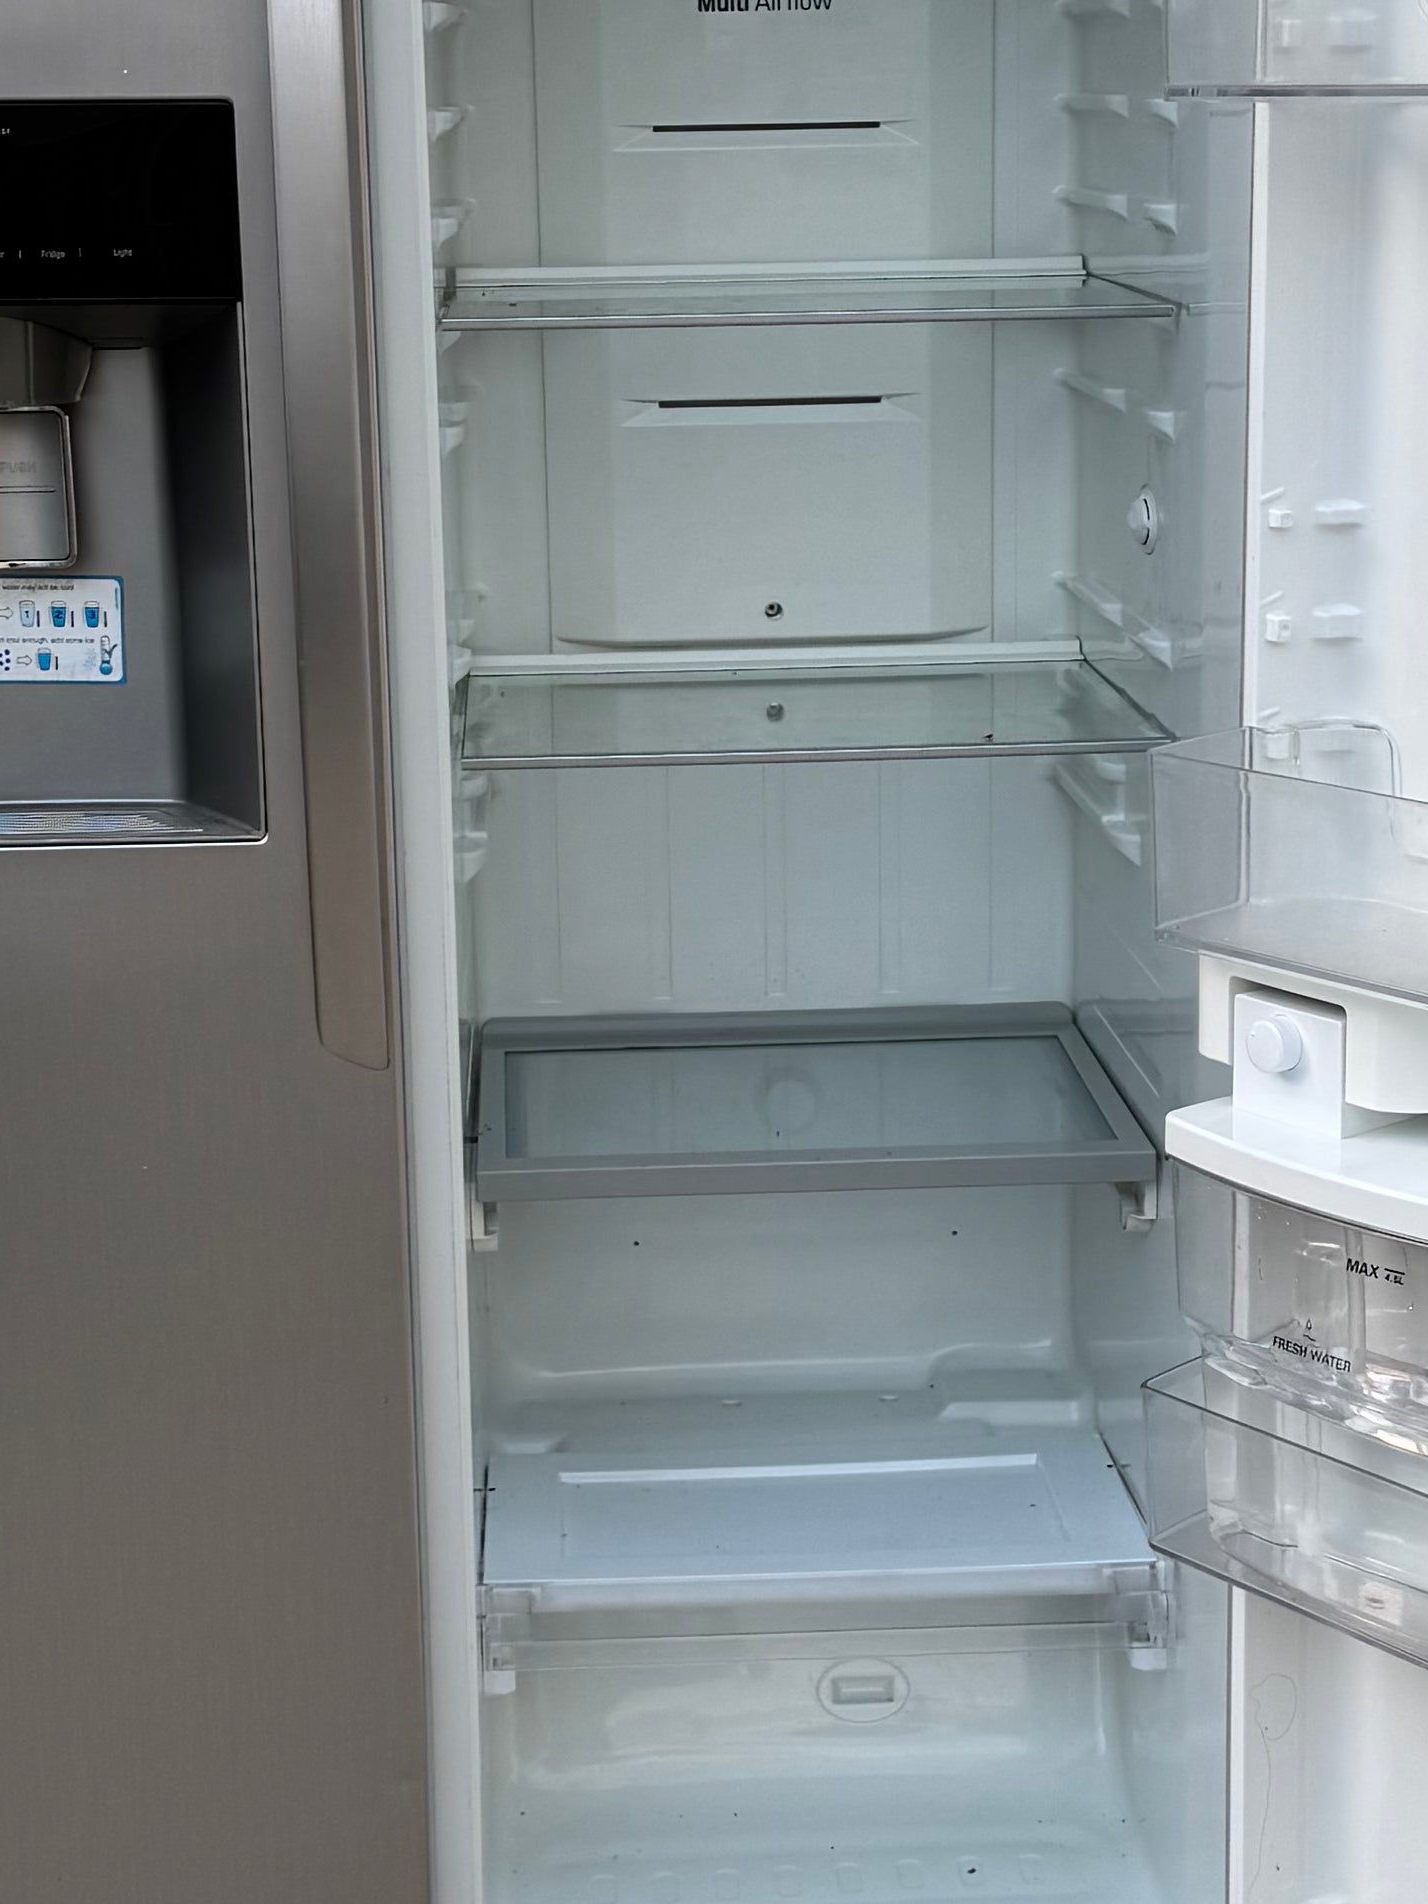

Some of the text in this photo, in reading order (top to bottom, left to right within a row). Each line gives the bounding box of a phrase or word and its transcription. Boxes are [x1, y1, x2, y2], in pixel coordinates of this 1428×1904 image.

[1345, 1258, 1380, 1279] MAX
[1273, 1336, 1351, 1373] FRESH WATER
